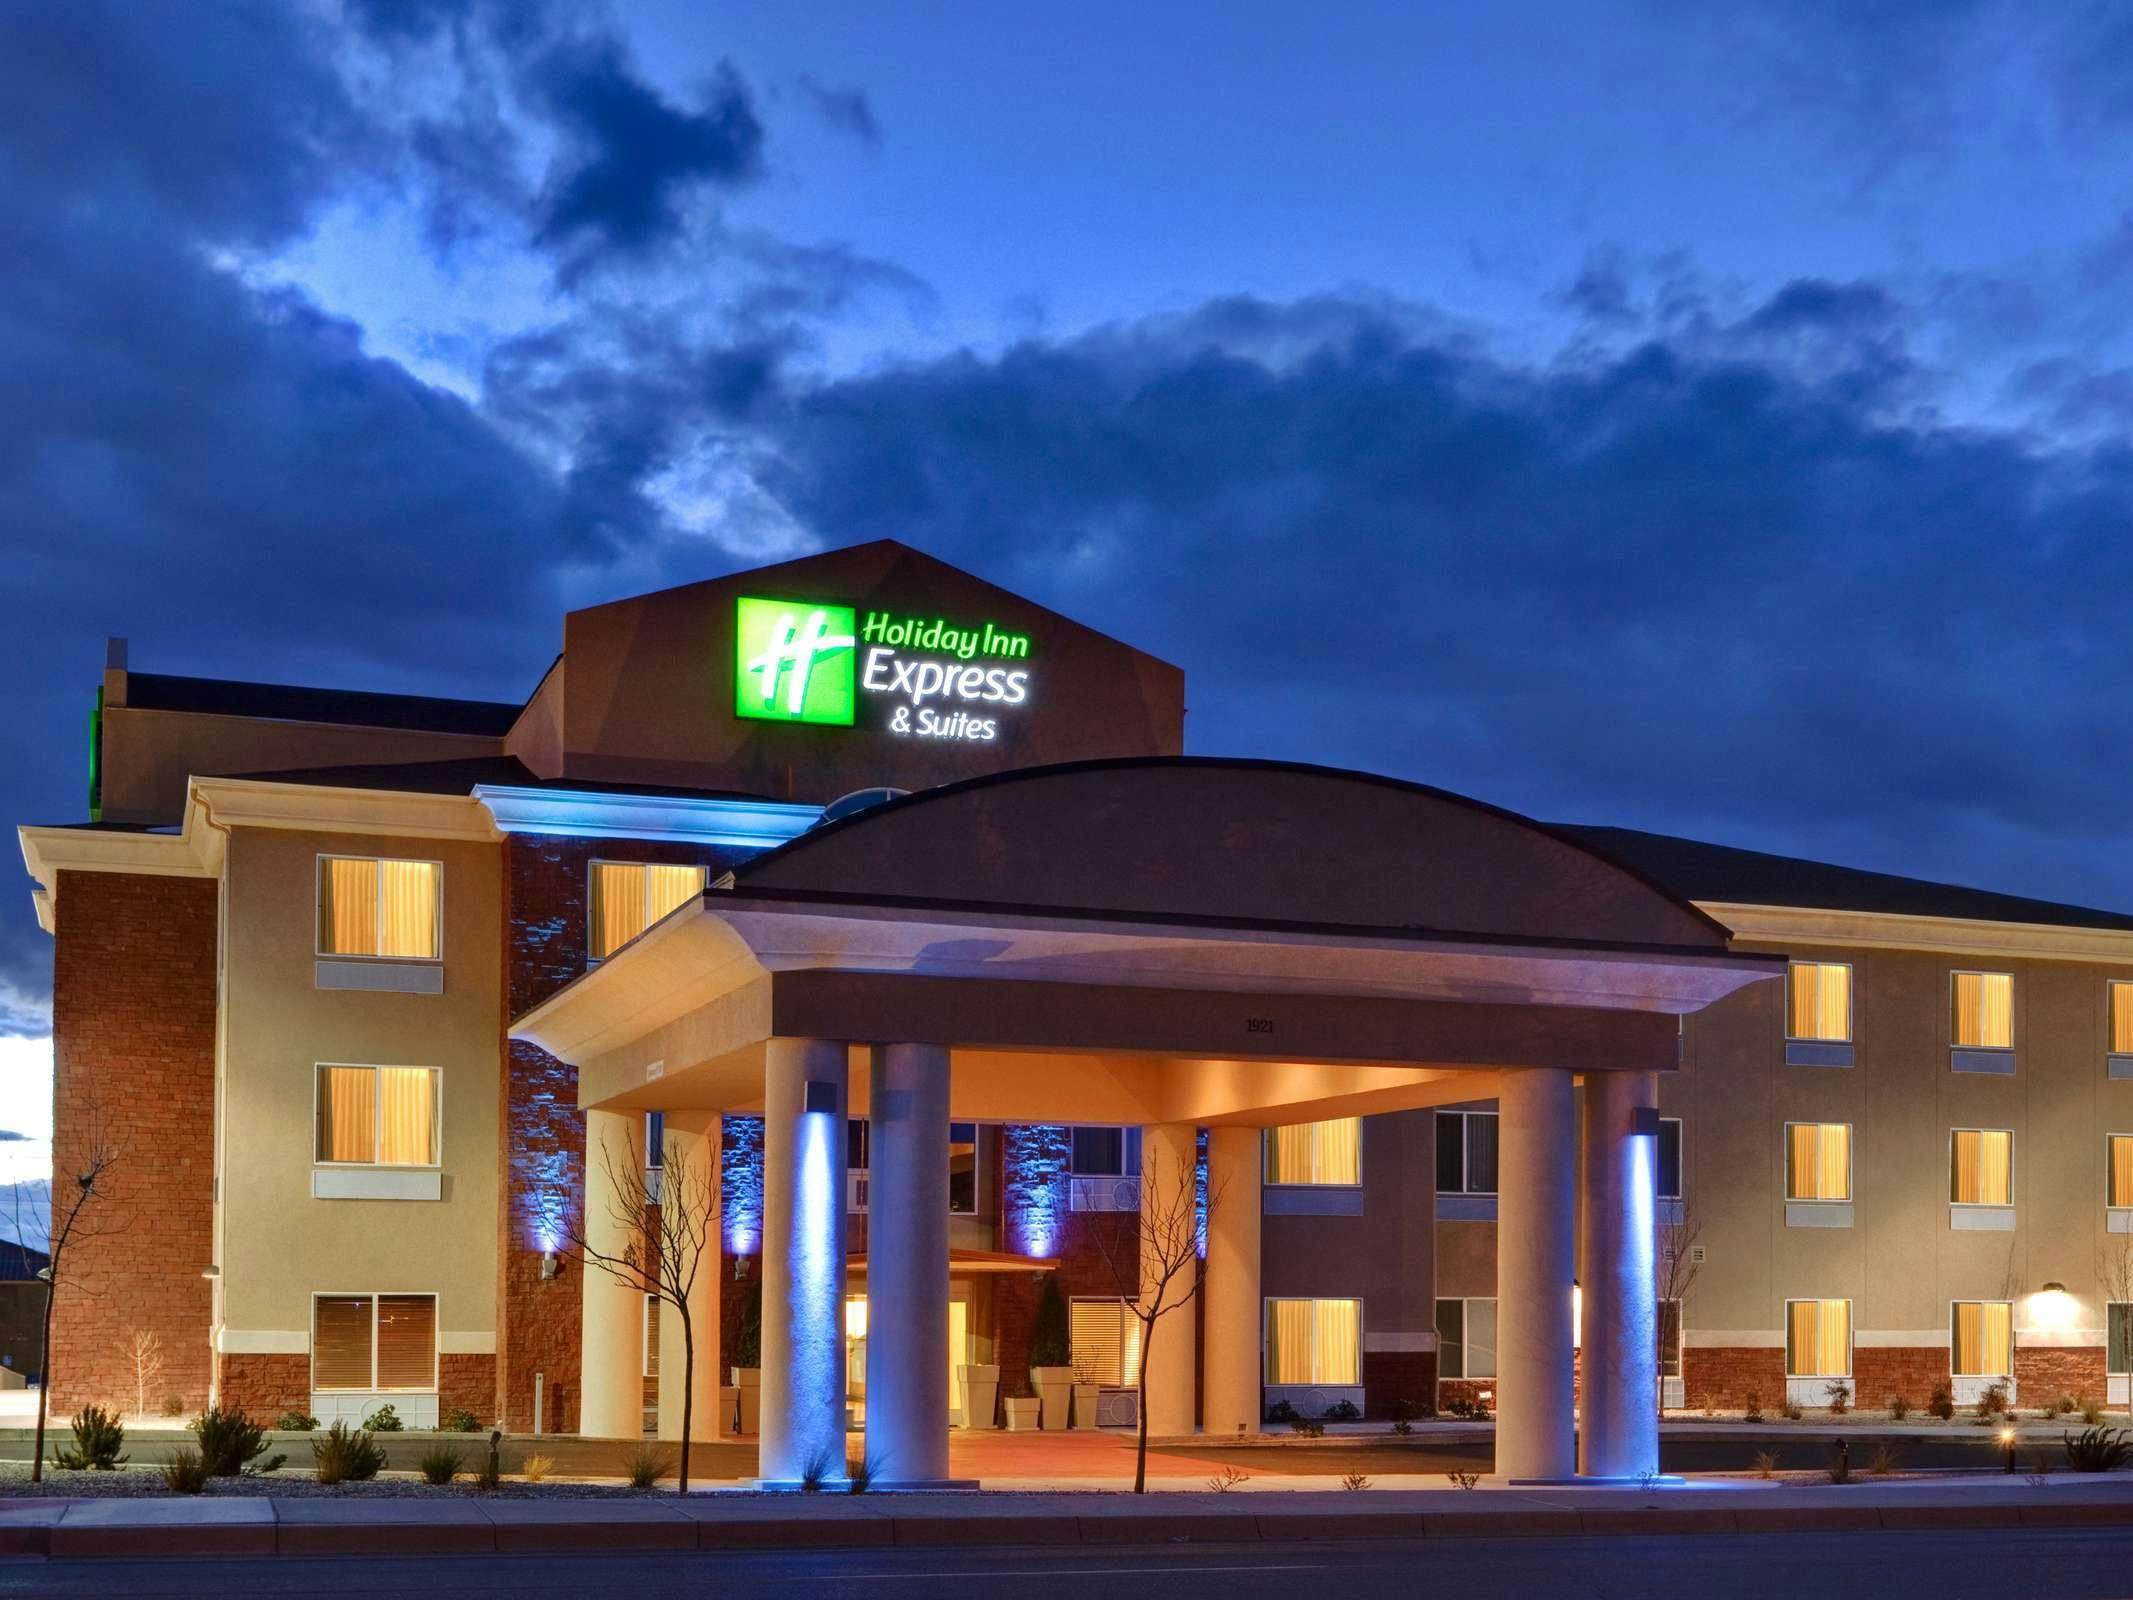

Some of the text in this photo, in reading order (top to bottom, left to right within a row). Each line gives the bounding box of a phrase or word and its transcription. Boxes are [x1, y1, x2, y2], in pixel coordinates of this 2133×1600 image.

[863, 612, 1029, 659] Holiday Inn
[862, 647, 1029, 706] Express
[889, 706, 996, 740] & Suites
[1246, 1018, 1273, 1033] 1921
